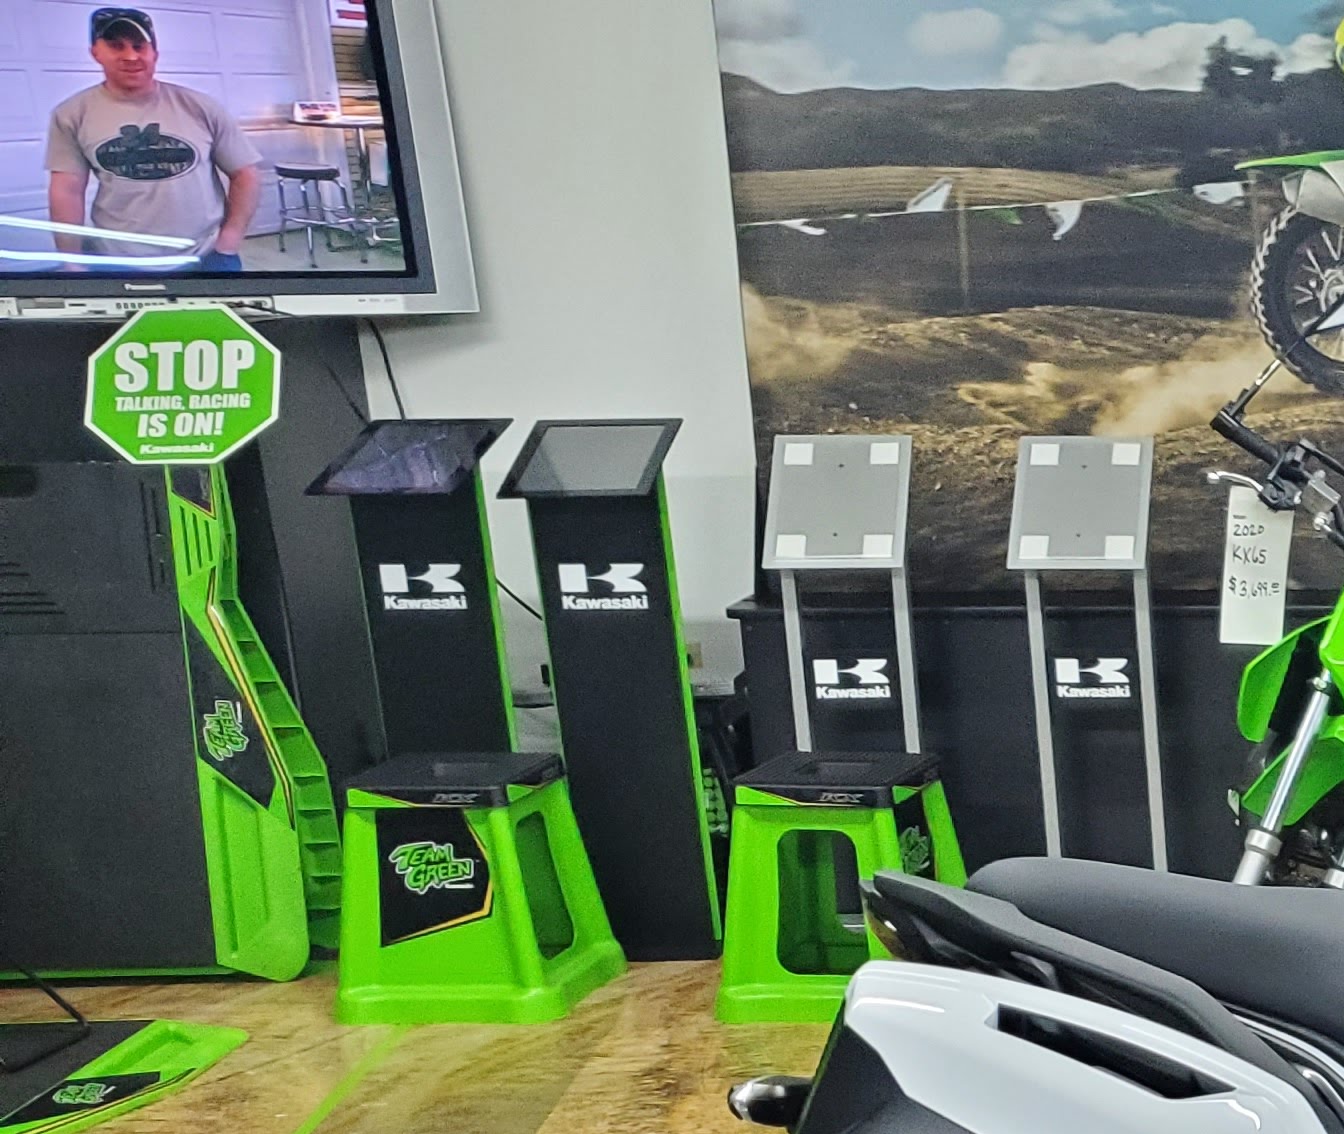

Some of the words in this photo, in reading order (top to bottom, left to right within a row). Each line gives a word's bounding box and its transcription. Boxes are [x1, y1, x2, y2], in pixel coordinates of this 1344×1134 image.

[114, 339, 256, 393] STOP
[115, 396, 185, 412] TALKING,
[189, 393, 251, 410] RACING
[137, 413, 169, 438] IS
[174, 411, 225, 437] ON!
[1232, 523, 1265, 537] 2020
[1231, 543, 1268, 566] KX65
[383, 594, 468, 611] Kawasaki
[561, 594, 650, 611] Kawasaki
[815, 684, 892, 700] Kawasaki
[1055, 683, 1132, 699] Kawasaki
[389, 842, 454, 874] TEAM
[405, 858, 474, 894] GREEN
